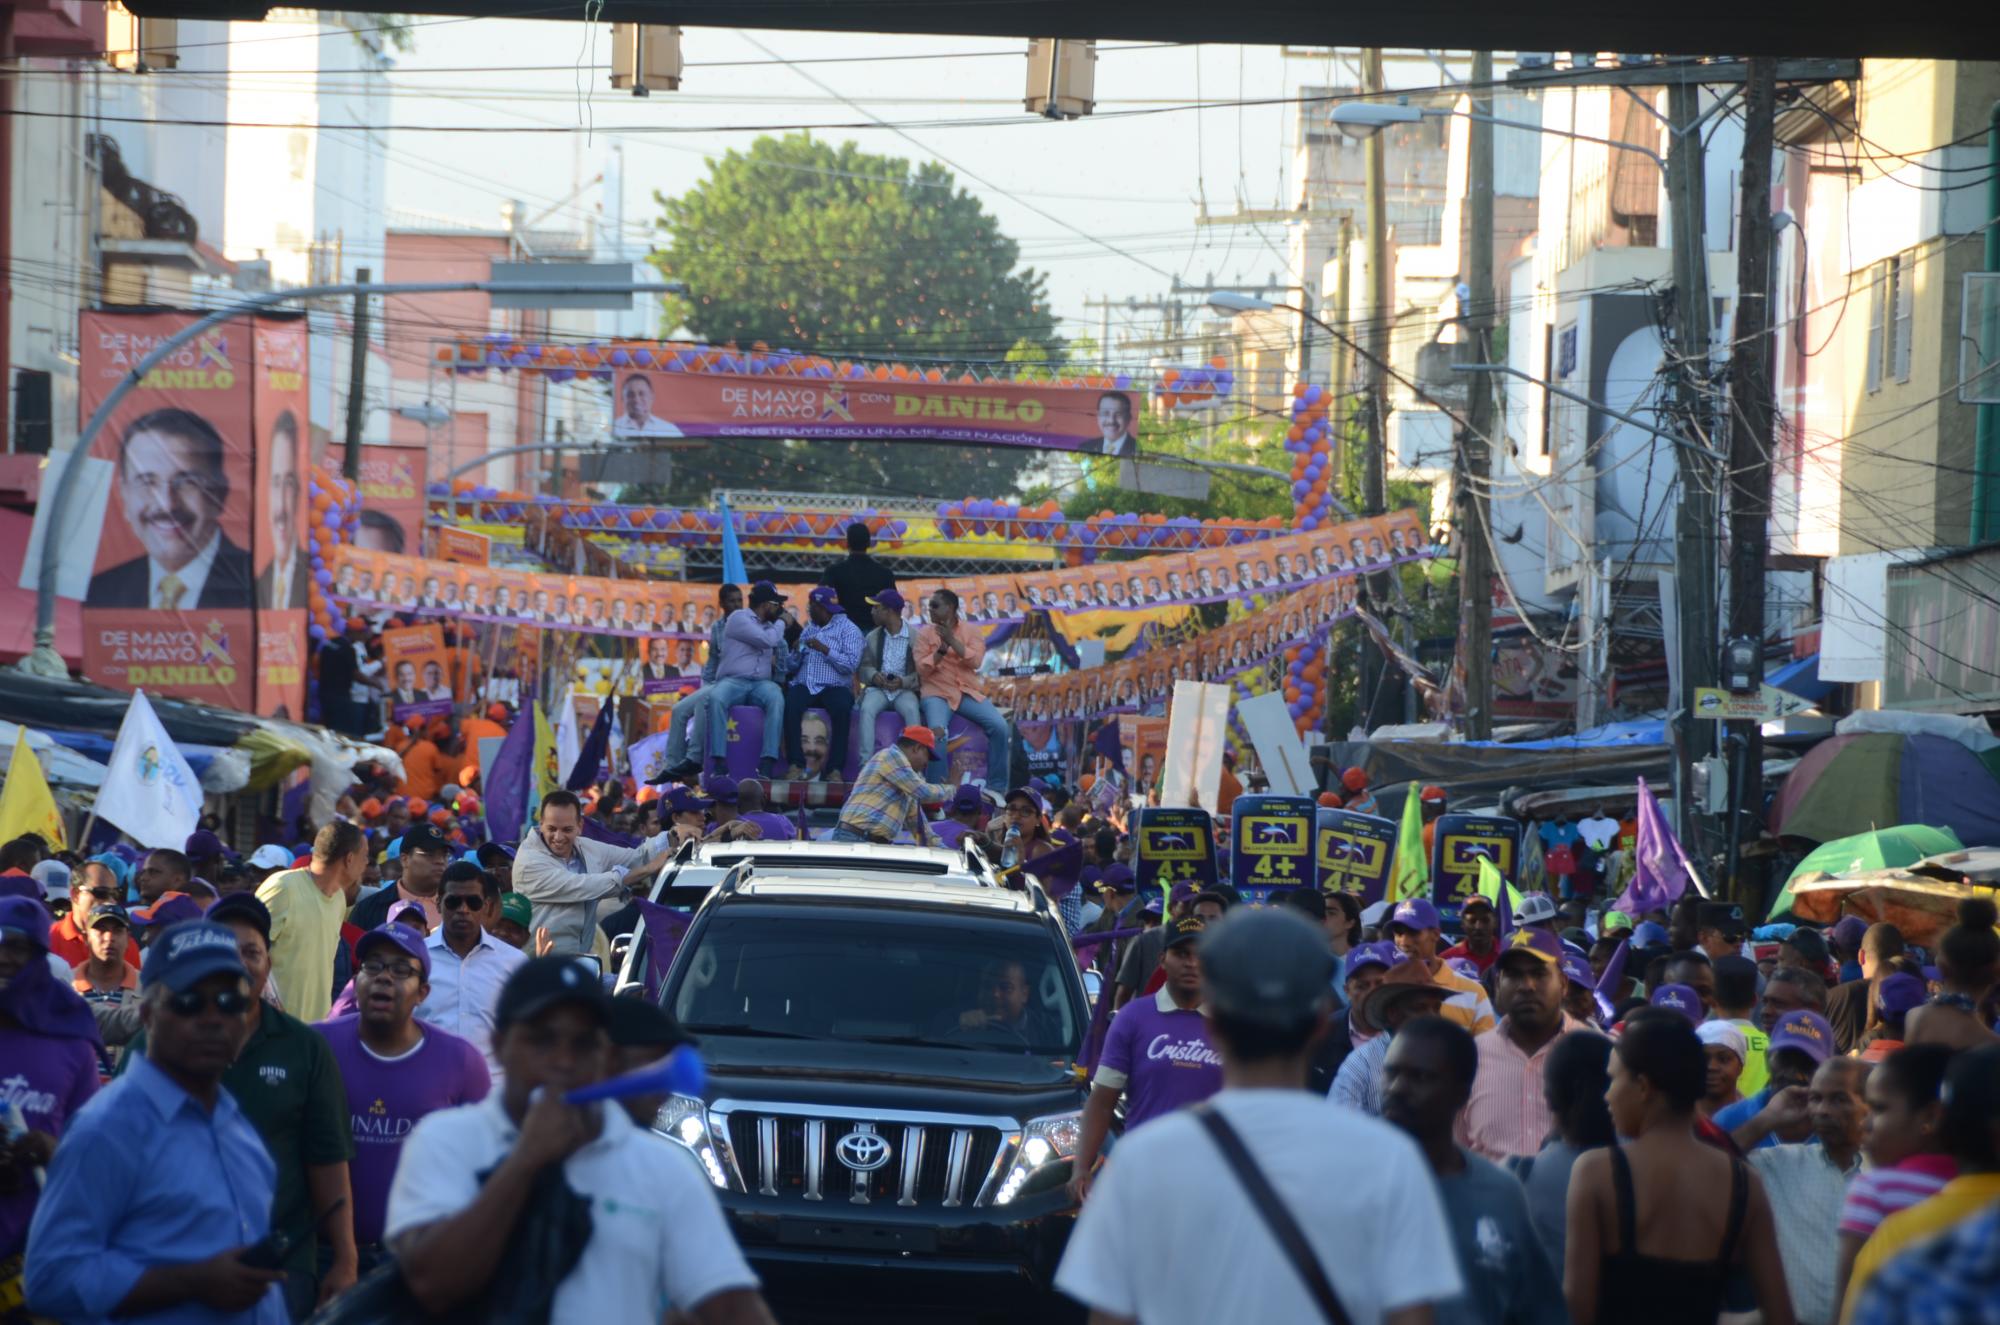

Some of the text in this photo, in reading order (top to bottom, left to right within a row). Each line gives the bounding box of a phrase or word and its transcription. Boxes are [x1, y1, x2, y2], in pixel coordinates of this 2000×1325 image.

[139, 369, 235, 390] ANILO
[722, 388, 817, 404] DE MAYO
[732, 404, 817, 419] A MAYO
[860, 393, 1045, 423] CON DANILO
[101, 632, 196, 647] DE MAYO
[112, 648, 196, 662] A MAYO
[128, 666, 236, 686] DANILO
[1254, 855, 1296, 877] 4+
[0, 1074, 57, 1114] tina
